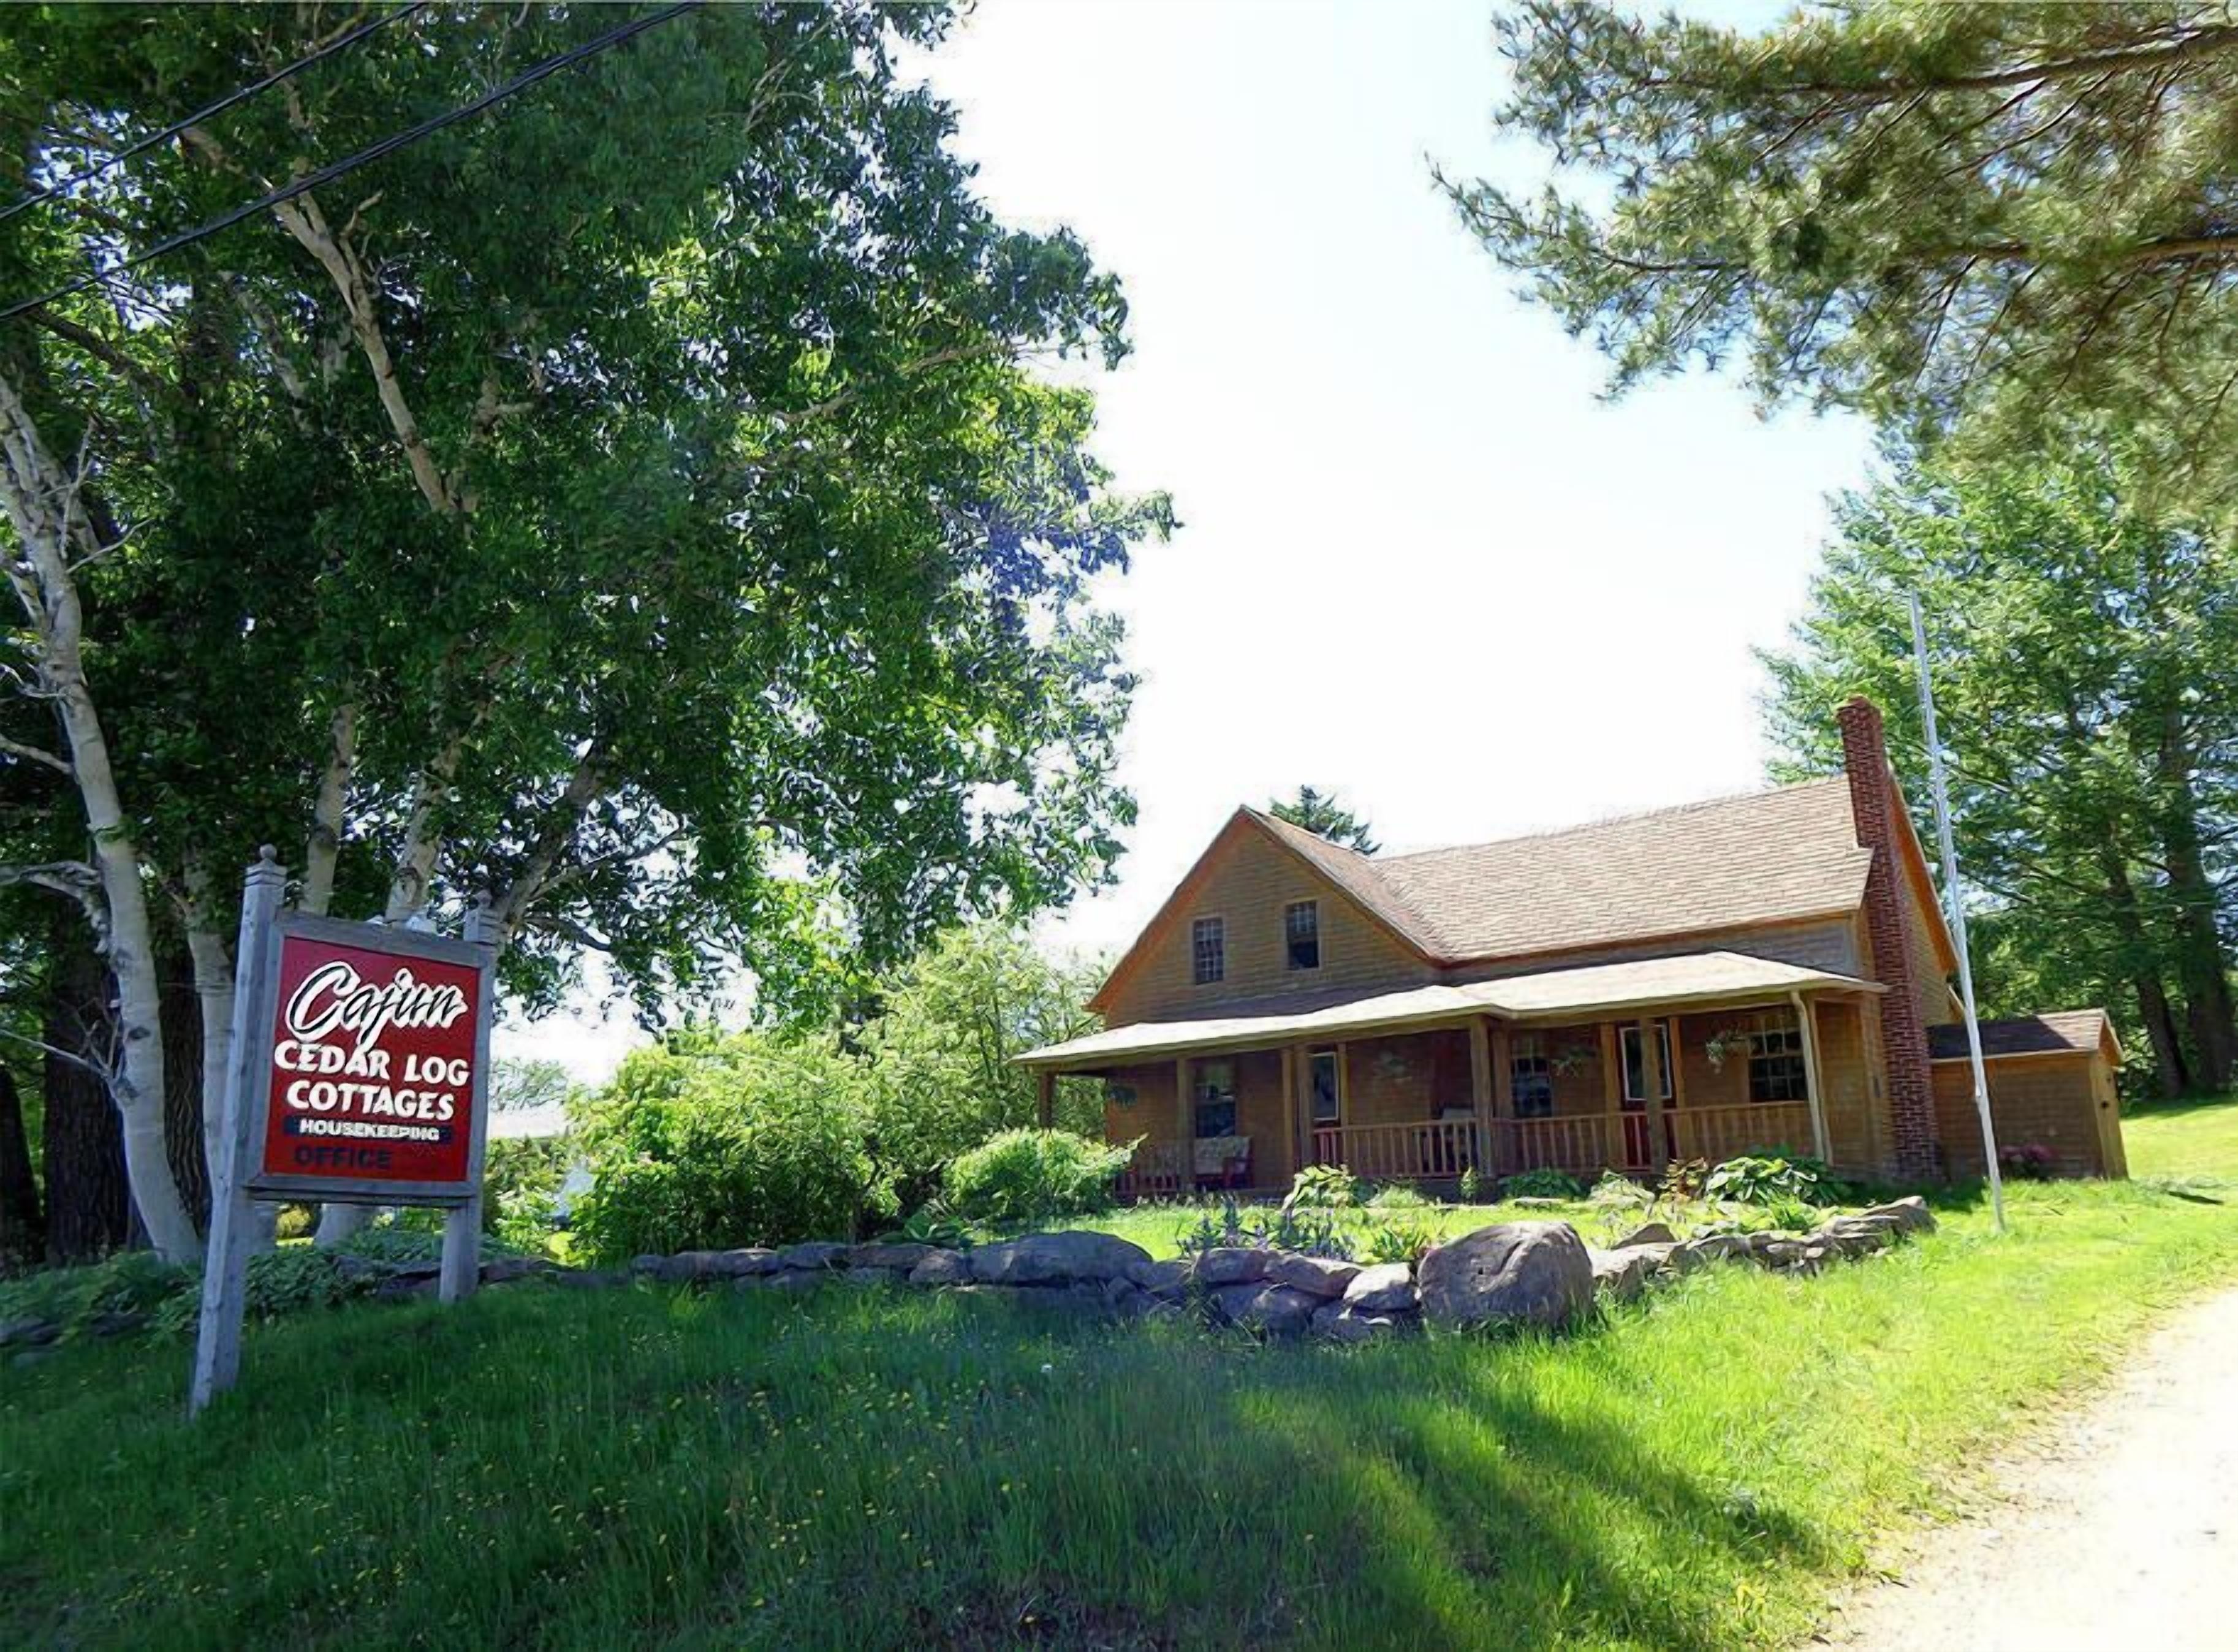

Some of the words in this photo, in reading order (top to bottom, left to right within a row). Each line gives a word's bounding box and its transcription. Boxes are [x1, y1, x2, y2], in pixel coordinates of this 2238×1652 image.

[286, 961, 468, 1054] Cajun
[274, 1039, 390, 1080] CEDAR
[404, 1054, 470, 1086] LOG
[286, 1080, 455, 1121] COTTAGES
[299, 1118, 440, 1141] HOUSEKEEPING
[294, 1146, 392, 1169] OFFICE
